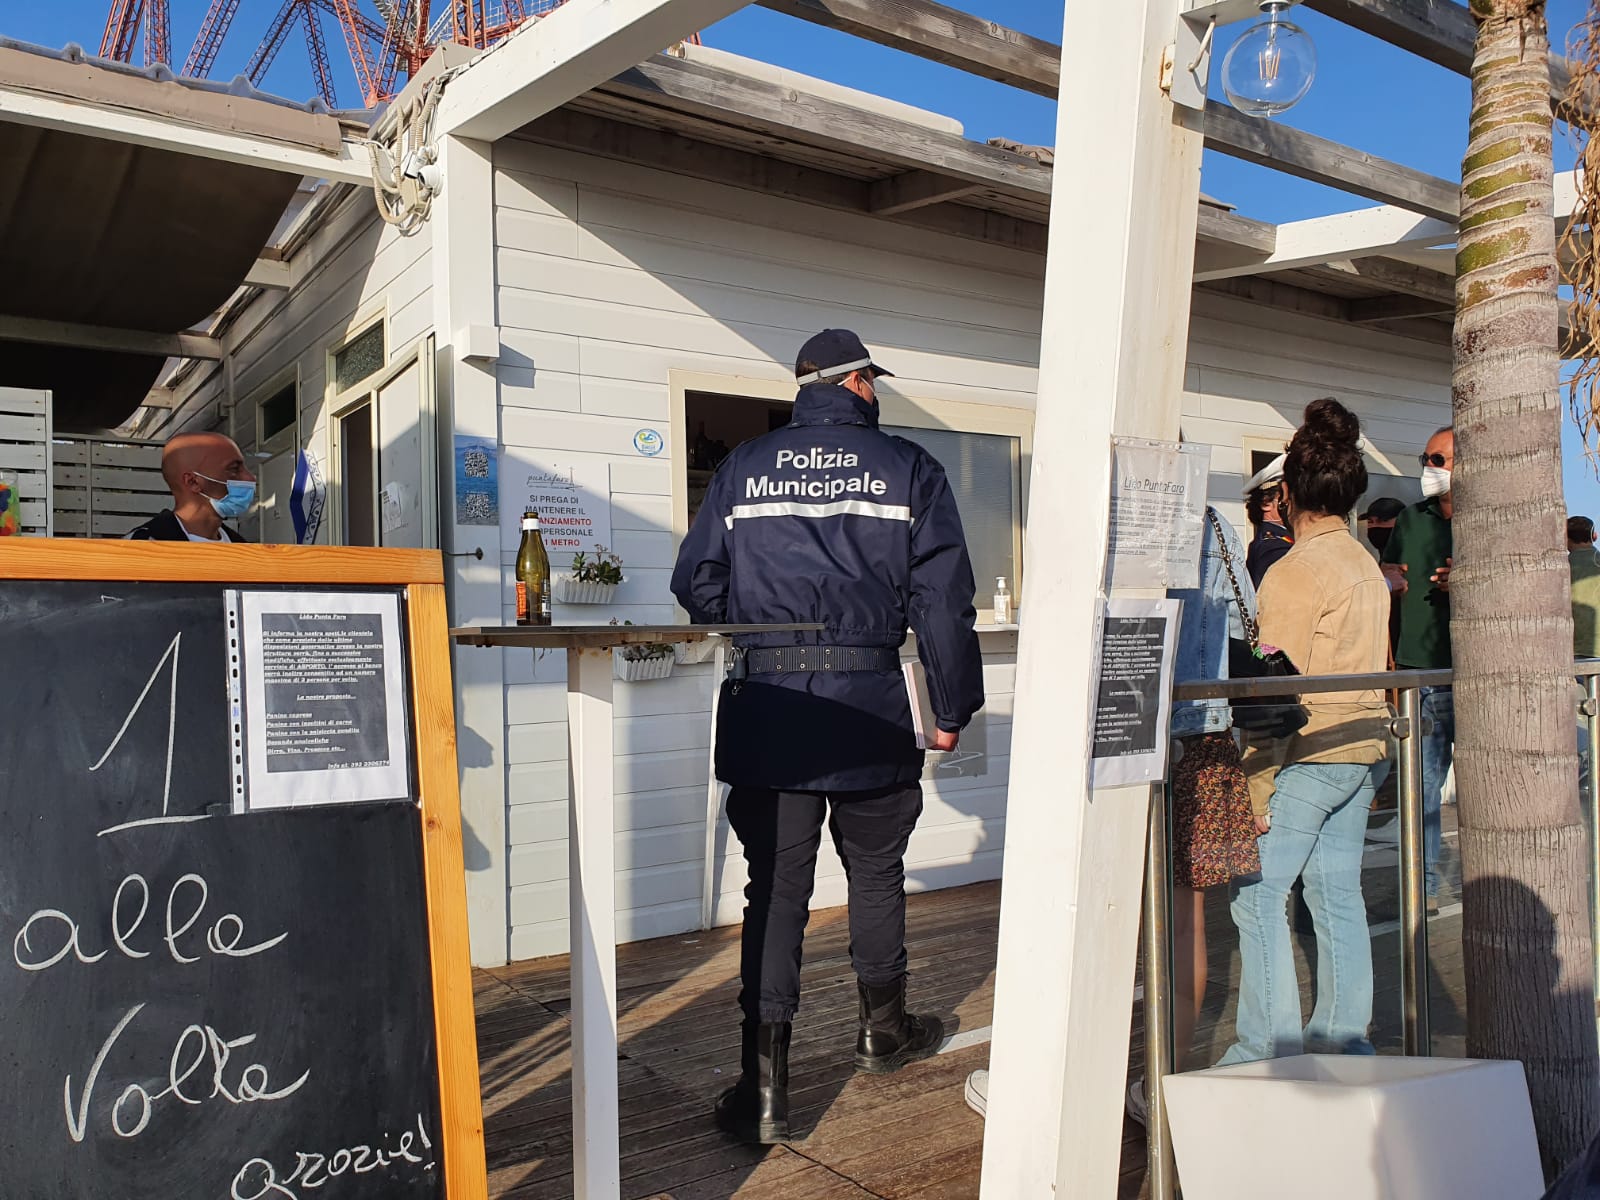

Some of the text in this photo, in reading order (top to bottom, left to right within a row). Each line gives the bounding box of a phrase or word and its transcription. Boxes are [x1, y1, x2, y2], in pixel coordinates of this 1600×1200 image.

[776, 448, 858, 469] Polizia
[745, 472, 887, 499] Municipale
[529, 494, 579, 504] SI PREGA DI
[525, 506, 586, 515] MANTENERE IL
[551, 538, 580, 547] METRO
[89, 631, 212, 836] 1
